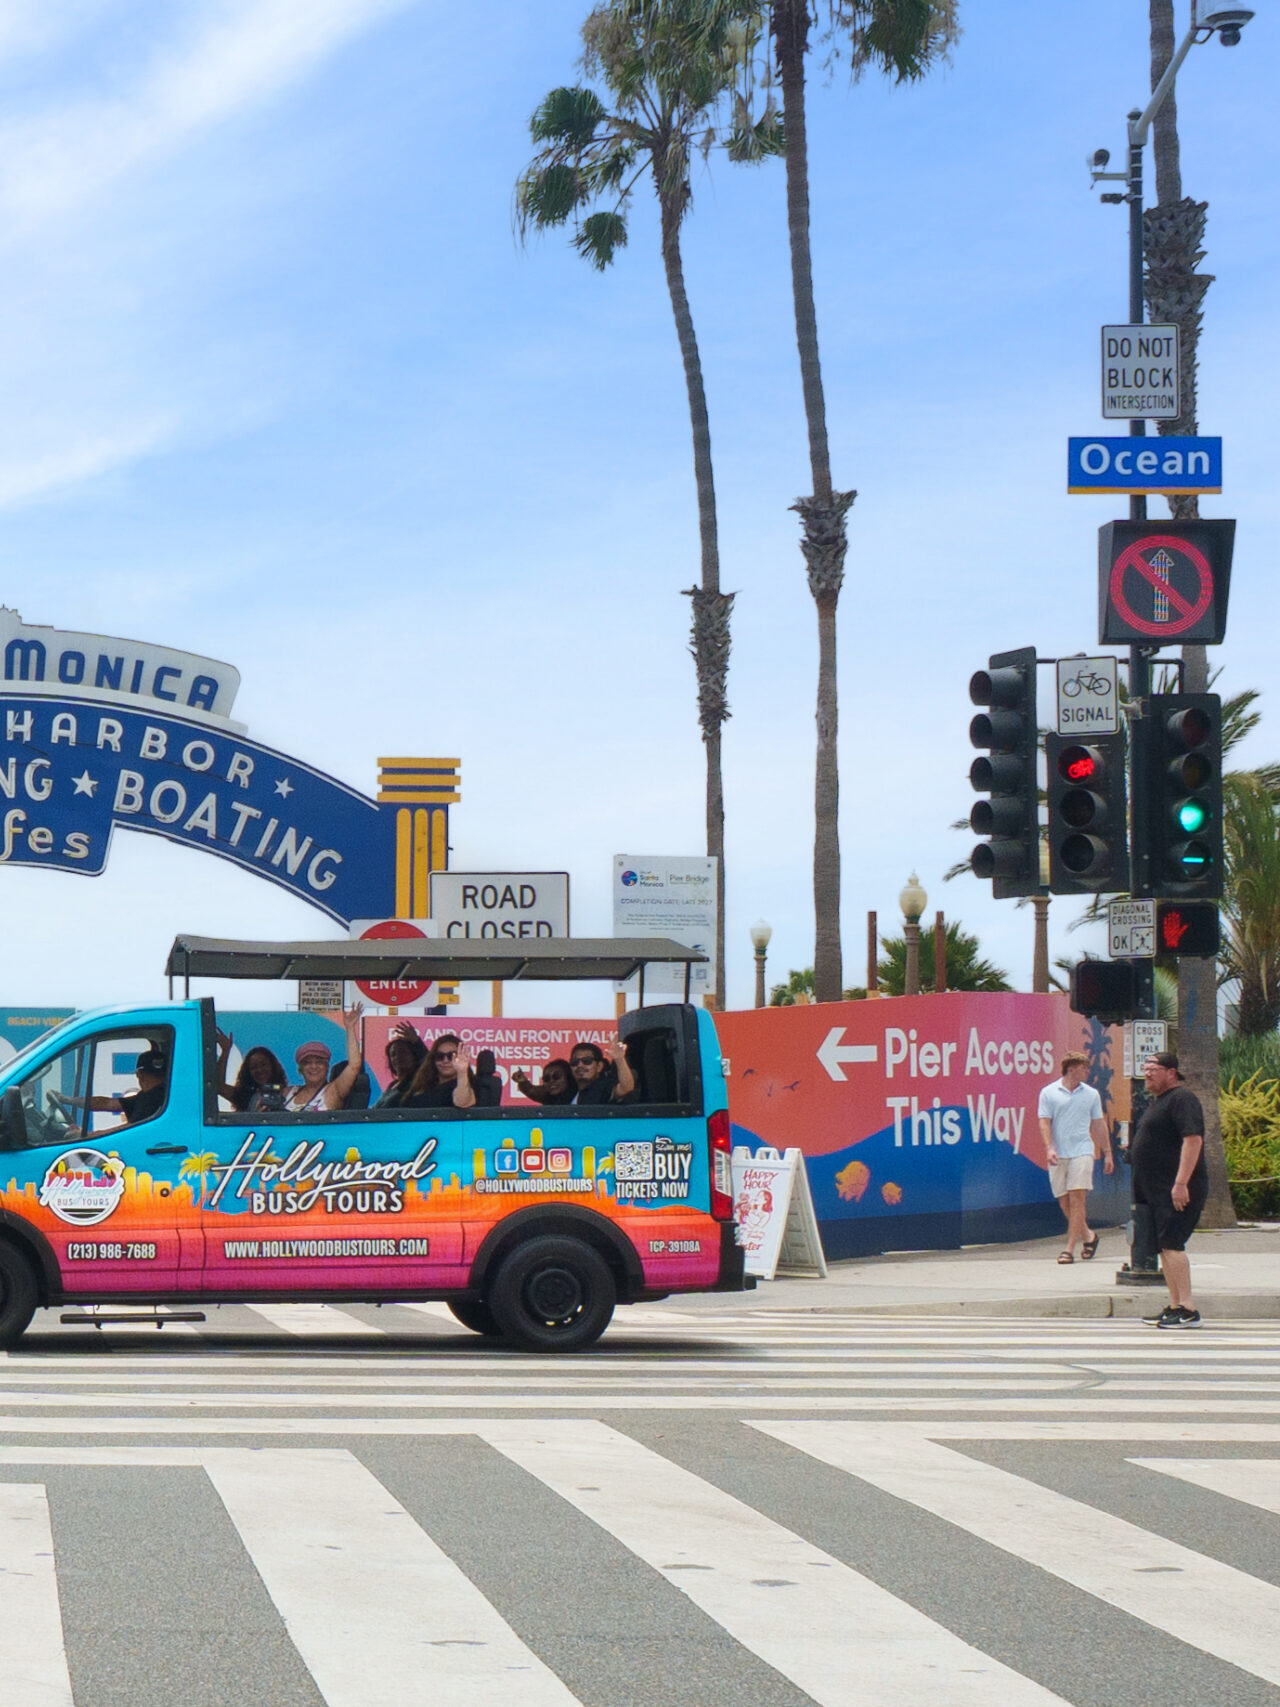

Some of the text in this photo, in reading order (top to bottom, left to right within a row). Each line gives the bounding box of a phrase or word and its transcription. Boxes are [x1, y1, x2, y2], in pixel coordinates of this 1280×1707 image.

[1107, 337, 1174, 358] DO NOT
[1107, 367, 1174, 389] BLOCK
[1106, 395, 1175, 410] INTERSECTION
[1079, 442, 1210, 476] Ocean
[4, 638, 219, 712] MONICA
[1061, 706, 1114, 724] SIGNAL
[6, 710, 255, 789] HARBOR
[113, 769, 343, 891] BOATING
[462, 884, 537, 910] ROAD
[1112, 904, 1151, 915] DIAGONAL
[1112, 914, 1152, 926] CROSSING
[447, 920, 553, 939] CLOSED
[1113, 935, 1128, 950] OK
[370, 980, 418, 990] ENTER
[7, 1017, 40, 1026] BEACH
[1136, 1026, 1163, 1035] CROSS
[460, 1028, 512, 1043] OCEAN
[520, 1029, 571, 1043] FRONT
[884, 1026, 1054, 1078] Pier Access
[1140, 1045, 1159, 1053] WALK
[886, 1093, 1025, 1155] This Way
[210, 1132, 438, 1211] Hollywood
[654, 1153, 693, 1180] BUY
[742, 1168, 779, 1181] HAPPY
[40, 1176, 124, 1206] Hollywood
[475, 1178, 594, 1193] @HOLLYWOODBUSTOURS
[615, 1181, 689, 1199] TICKETS NOW
[743, 1180, 772, 1190] HOUR
[57, 1198, 110, 1206] BUS TOURS
[252, 1190, 404, 1214] BUS TOURS
[67, 1242, 98, 1260] (213)
[100, 1242, 156, 1260] 986-7688
[223, 1239, 428, 1259] WWW.HOLLYWOODBUSTOURS.COM
[648, 1240, 701, 1253] TCP-39108A
